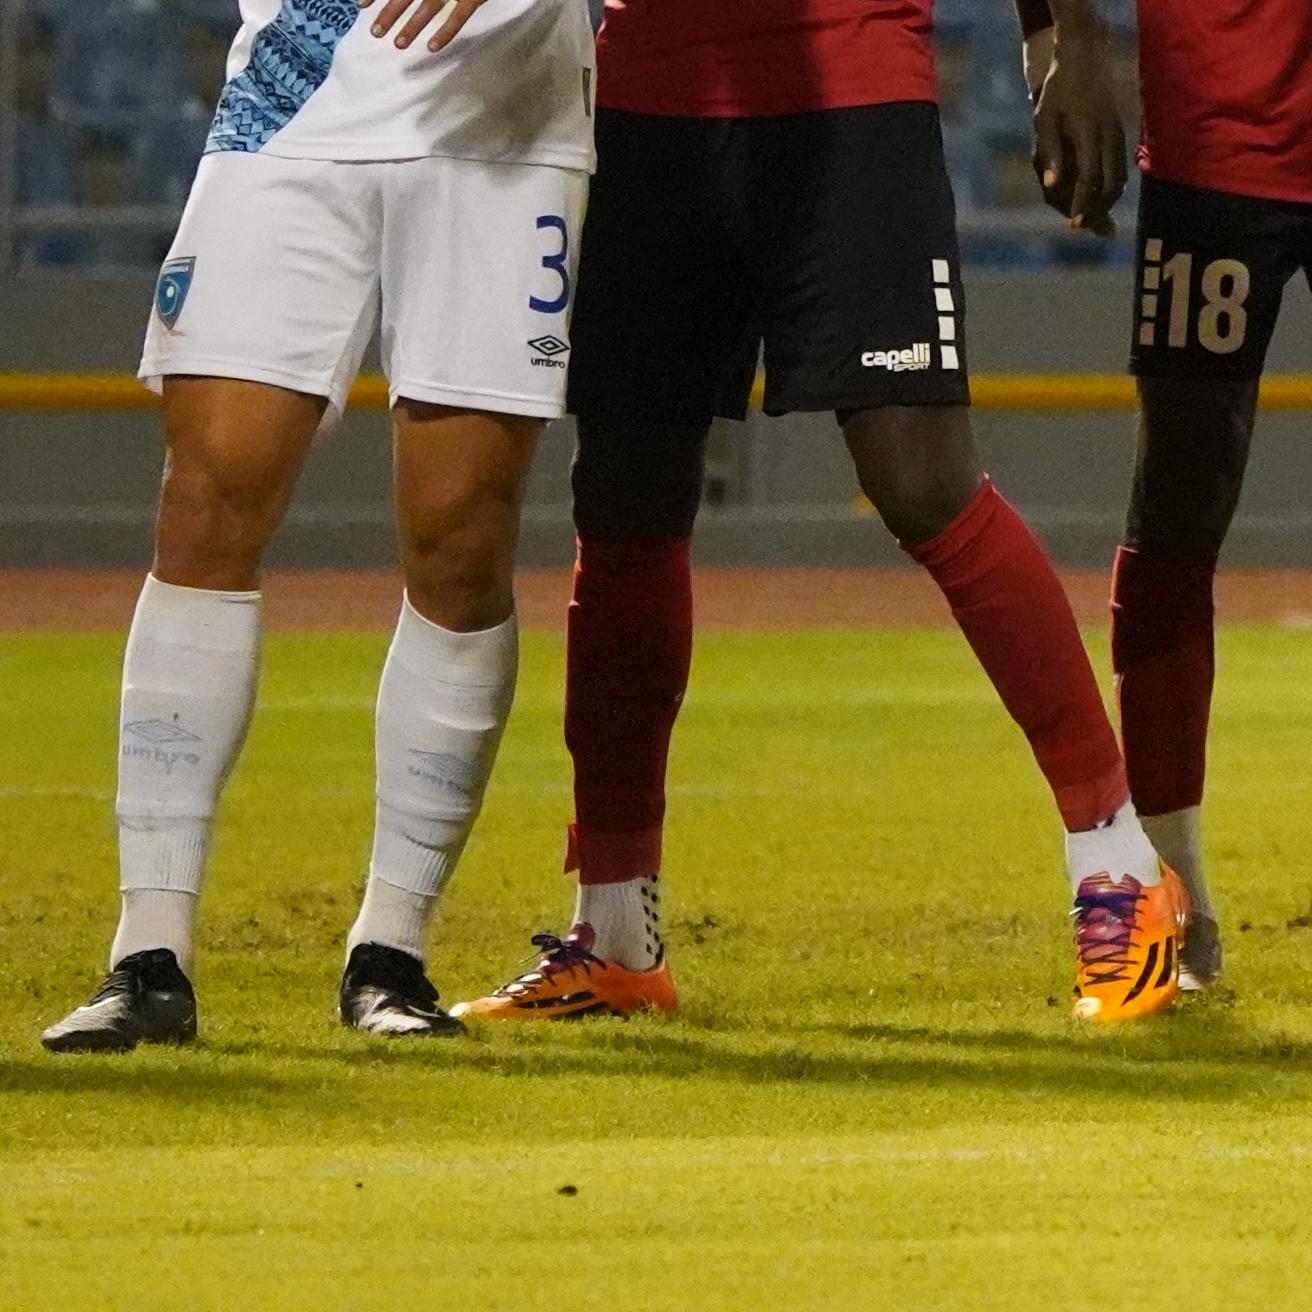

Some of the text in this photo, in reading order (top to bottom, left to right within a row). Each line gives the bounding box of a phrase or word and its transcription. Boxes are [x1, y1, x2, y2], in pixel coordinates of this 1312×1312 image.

[529, 214, 570, 314] 3
[1162, 252, 1251, 355] 18
[530, 356, 566, 369] umbro
[861, 343, 931, 370] capelli
